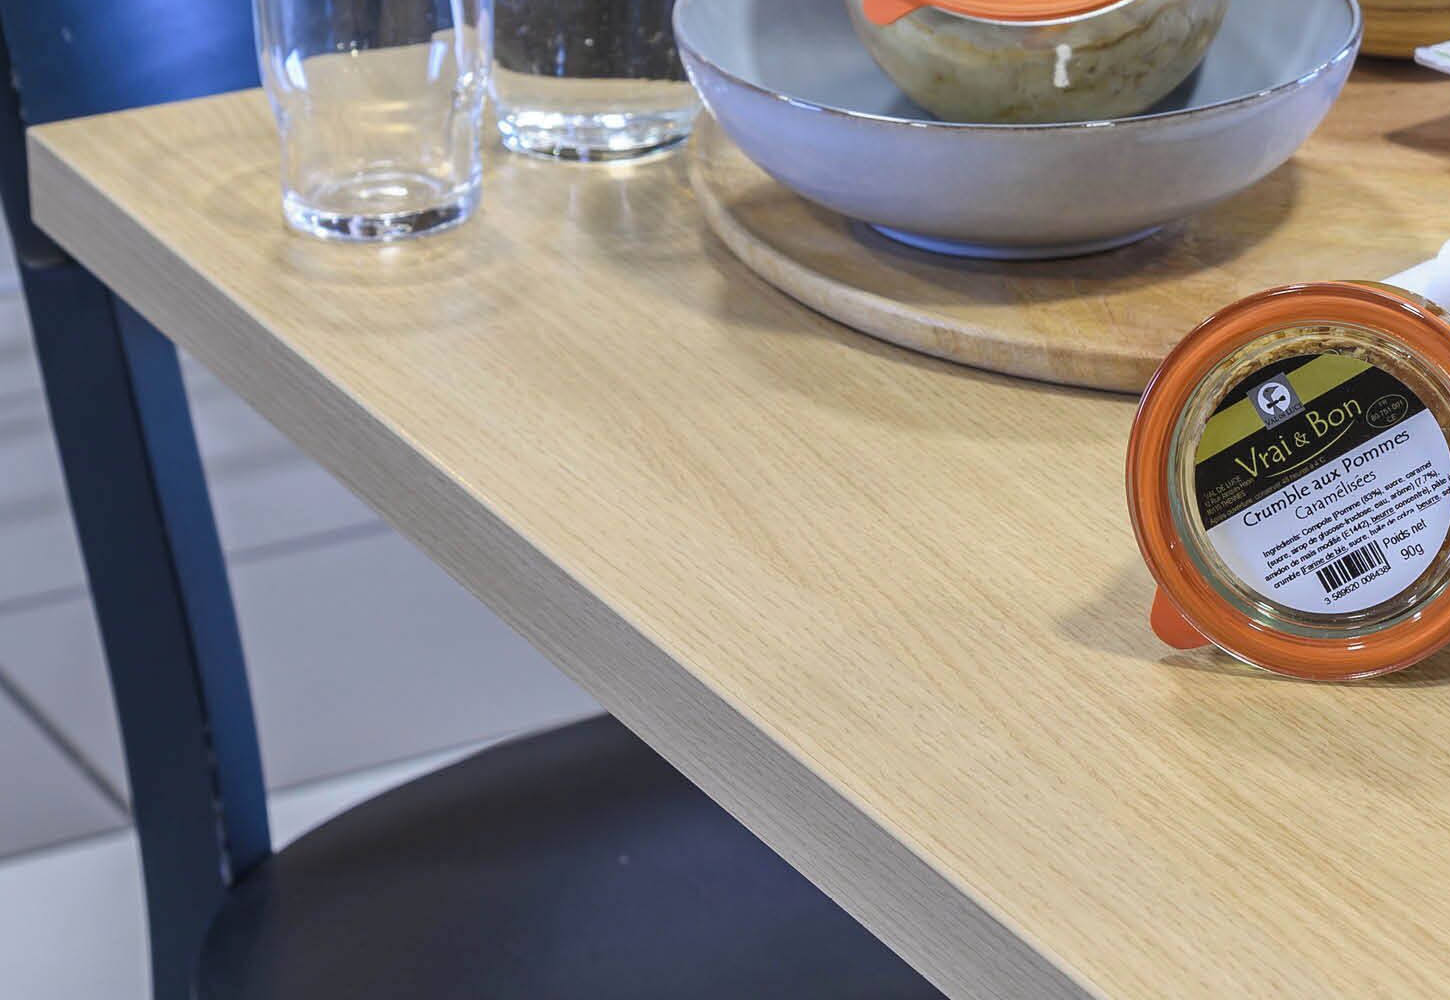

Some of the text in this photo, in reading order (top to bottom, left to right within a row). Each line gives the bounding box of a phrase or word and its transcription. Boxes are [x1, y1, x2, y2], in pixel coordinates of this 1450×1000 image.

[1235, 392, 1361, 479] Vrai & Bon
[1265, 415, 1280, 427] VAL
[1240, 480, 1311, 527] Crumble
[1311, 468, 1341, 491] aux
[1341, 427, 1410, 472] Pommes
[1293, 467, 1377, 521] Caramélisées
[1301, 515, 1333, 537] Compote
[1404, 460, 1432, 479] caramel
[1263, 563, 1290, 581] amidon
[1289, 558, 1299, 567] de
[1370, 506, 1394, 523] beurre
[1266, 550, 1291, 568] (sucre,
[1290, 542, 1308, 556] sirop
[1307, 536, 1318, 545] de
[1373, 497, 1390, 509] eau,
[1272, 569, 1301, 589] crumble
[1324, 551, 1335, 560] de
[1385, 517, 1396, 526] de
[1382, 518, 1426, 548] Poids net
[1400, 541, 1424, 561] 90g
[1323, 596, 1331, 605] 3
